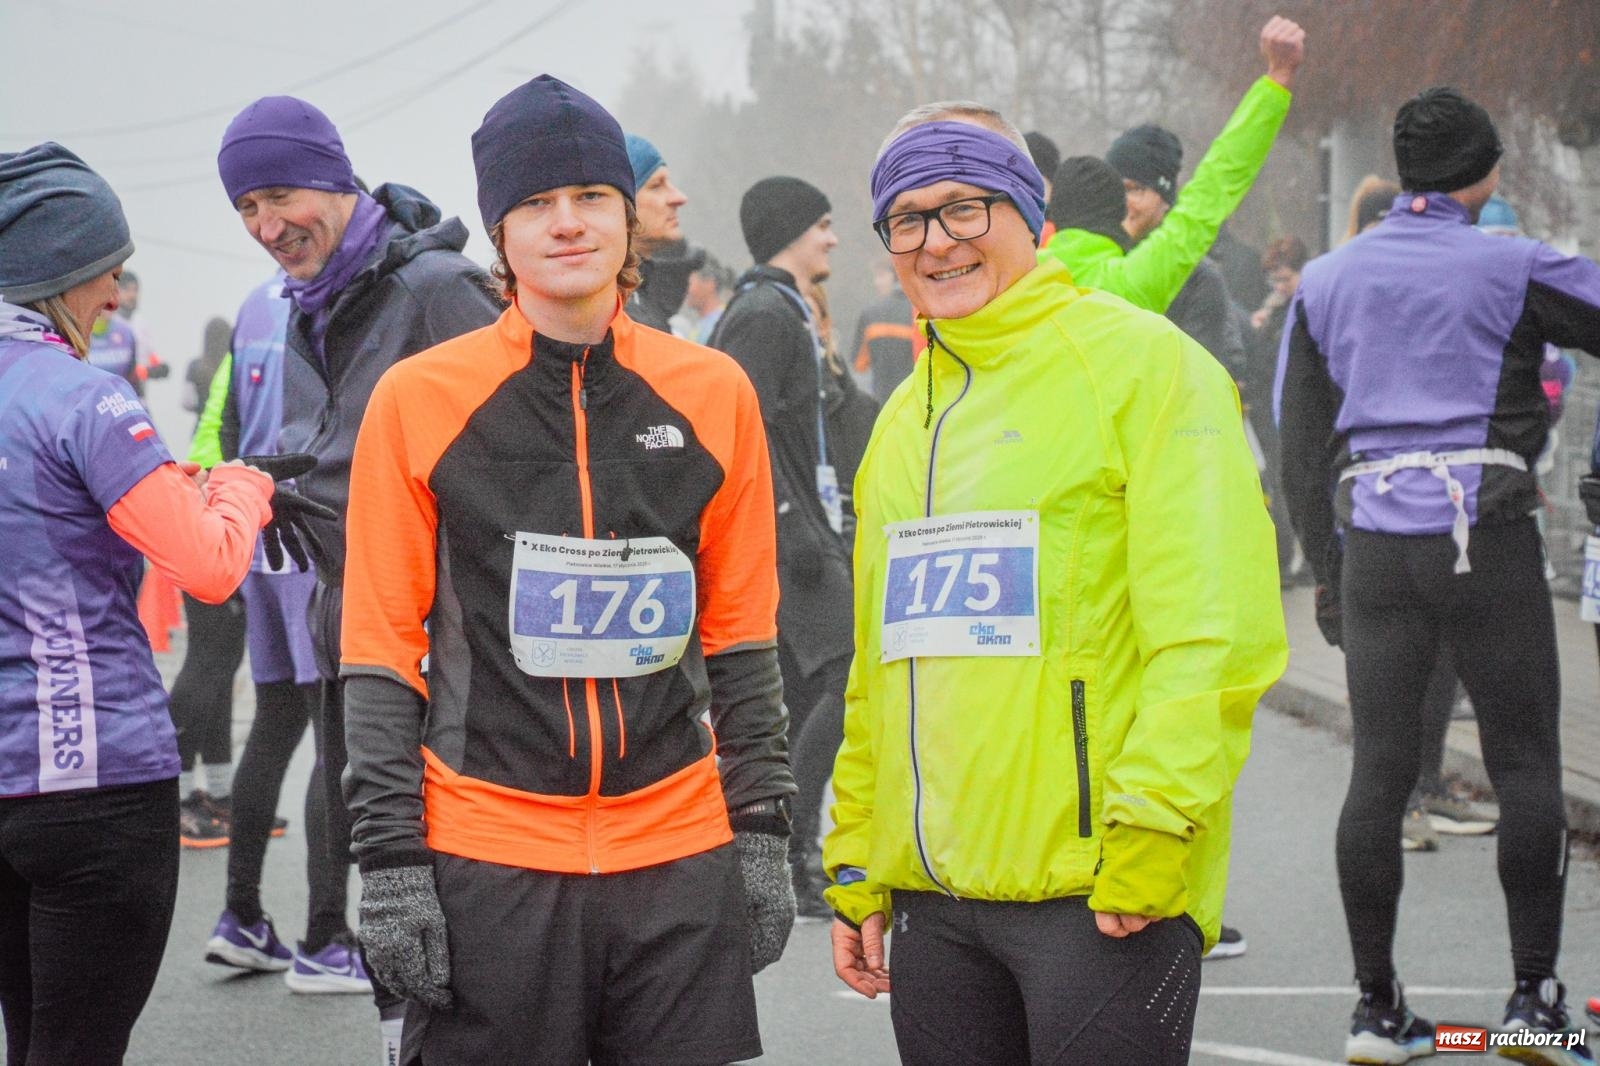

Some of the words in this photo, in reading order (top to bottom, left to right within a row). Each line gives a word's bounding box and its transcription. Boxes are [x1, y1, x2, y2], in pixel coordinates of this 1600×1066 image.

[636, 431, 669, 443] NORTH
[647, 425, 667, 436] THE
[645, 440, 670, 450] FACE
[905, 530, 916, 538] Eko
[917, 528, 936, 536] Cross
[936, 527, 945, 536] po
[946, 520, 965, 532] Ziemi
[965, 518, 1022, 531] Pietrowickiej
[531, 543, 538, 551] X
[540, 544, 557, 553] Eko
[559, 545, 586, 556] Cross
[588, 548, 600, 559] po
[602, 547, 624, 557] Ziem
[905, 553, 1001, 616] 175
[550, 578, 665, 635] 176
[969, 621, 995, 635] eko
[630, 644, 653, 656] eko
[41, 609, 84, 770] RUNNERS
